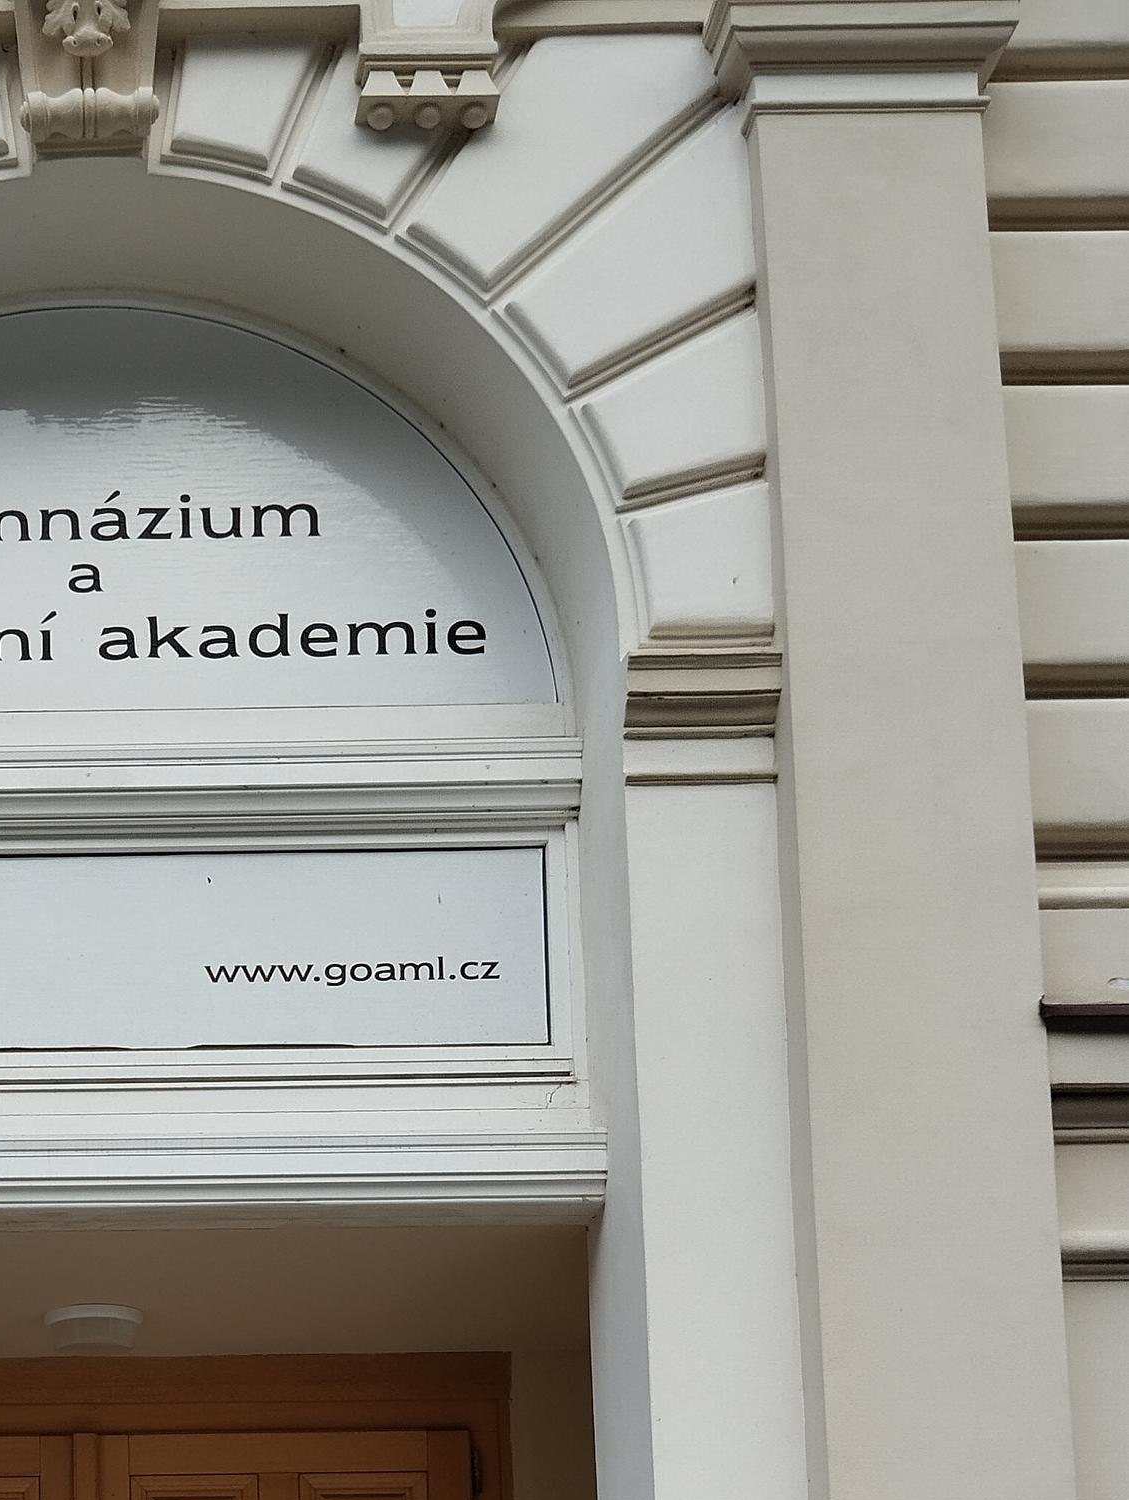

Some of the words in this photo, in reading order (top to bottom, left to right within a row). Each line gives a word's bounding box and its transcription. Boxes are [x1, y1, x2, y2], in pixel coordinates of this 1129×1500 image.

[69, 564, 102, 592] a
[99, 609, 487, 661] akademie
[205, 956, 500, 986] www.goaml.cz
